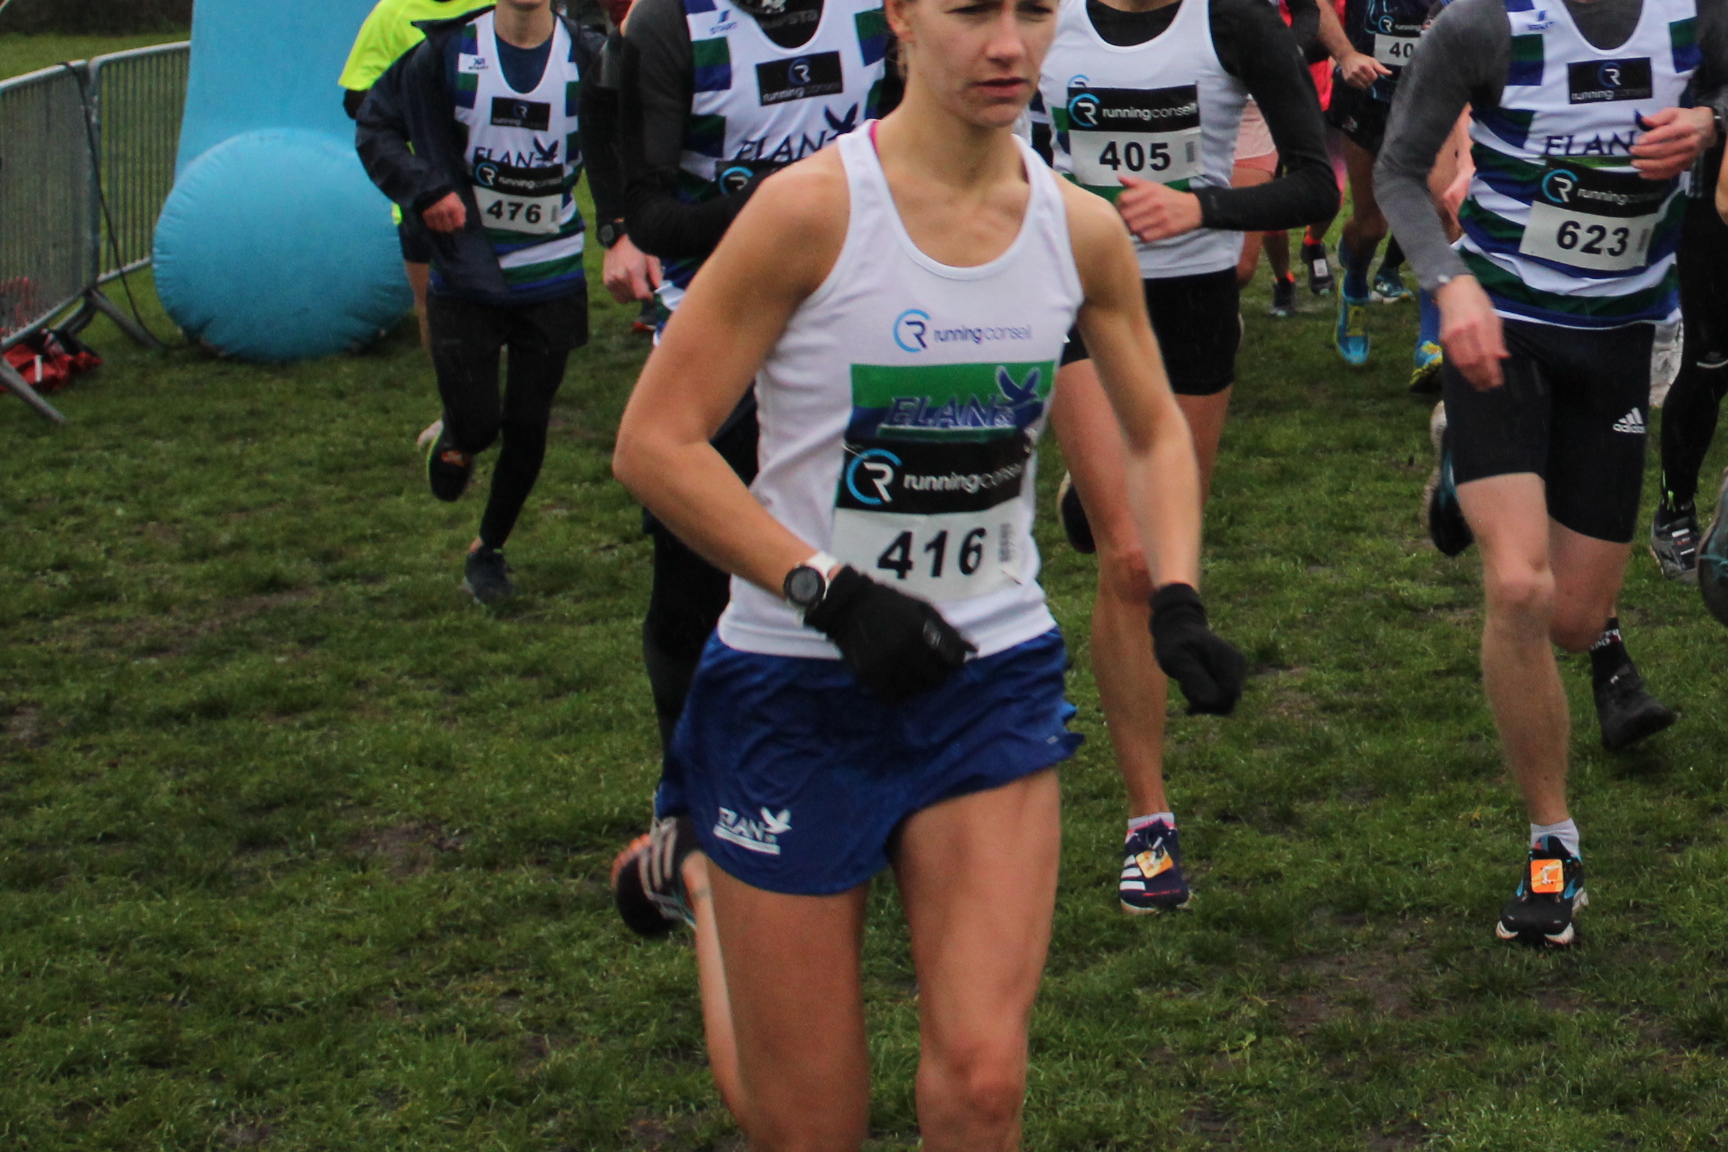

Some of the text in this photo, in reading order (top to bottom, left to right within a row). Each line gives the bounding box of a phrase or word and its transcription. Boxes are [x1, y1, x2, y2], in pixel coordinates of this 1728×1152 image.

[1099, 141, 1171, 171] 405
[487, 199, 542, 224] 476
[1557, 220, 1630, 257] 623
[877, 527, 988, 579] 416
